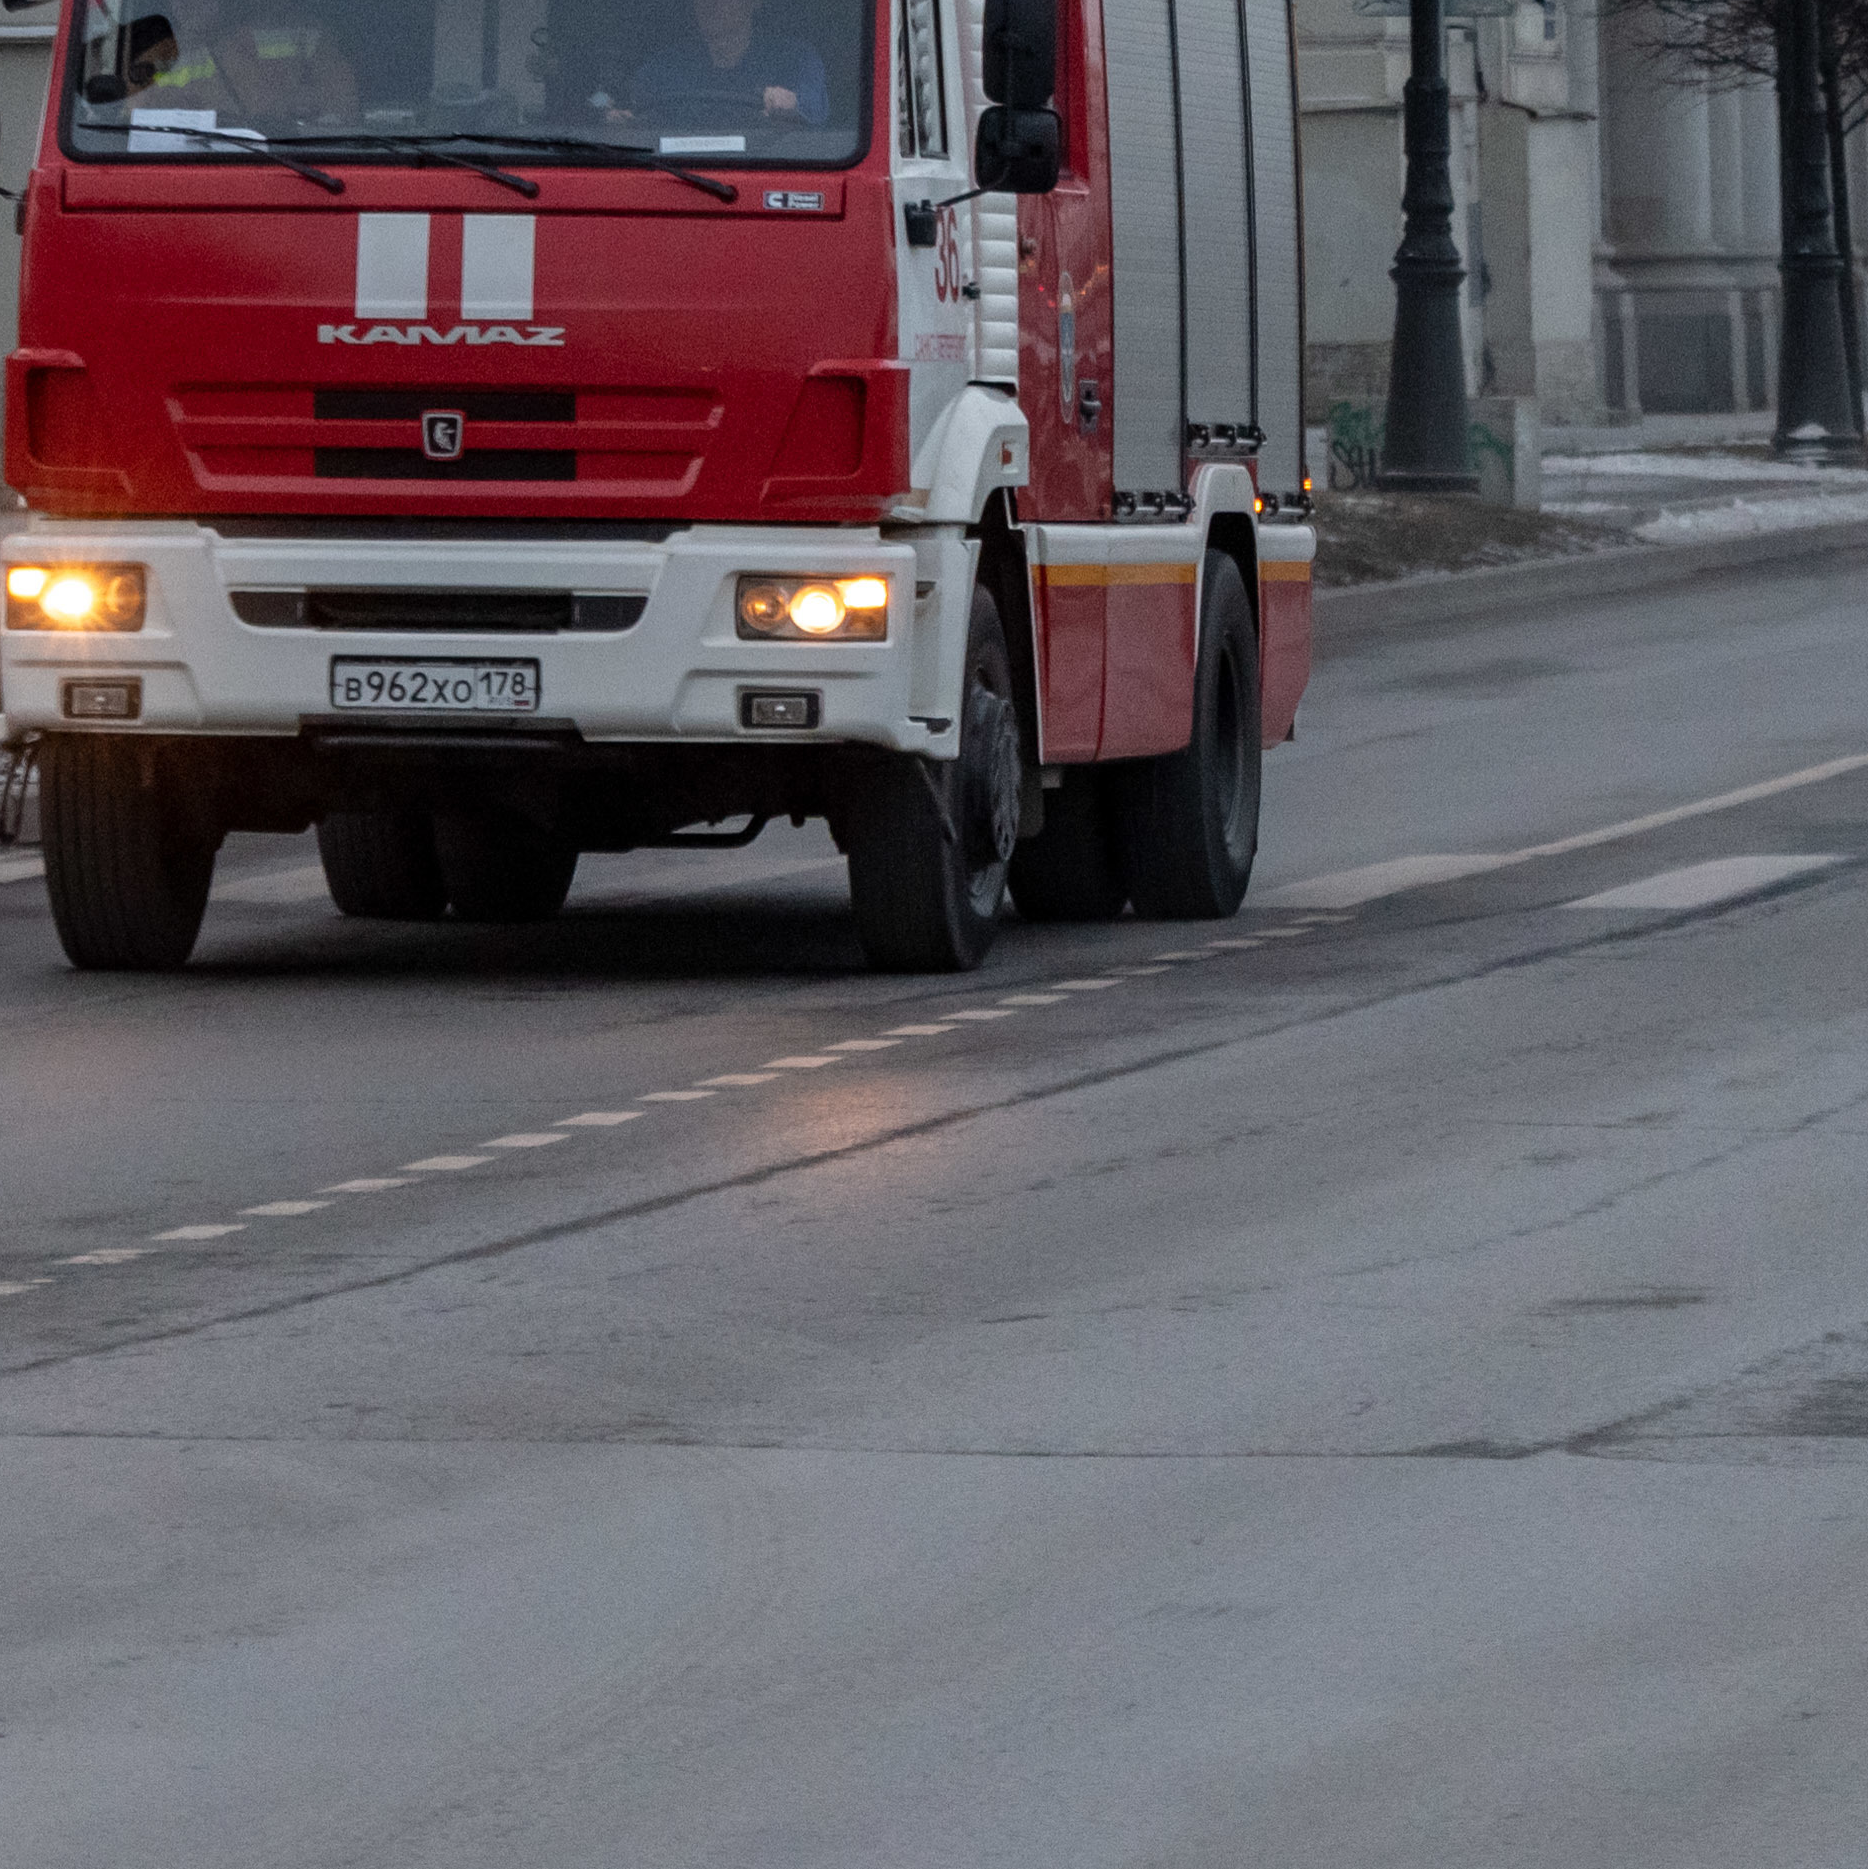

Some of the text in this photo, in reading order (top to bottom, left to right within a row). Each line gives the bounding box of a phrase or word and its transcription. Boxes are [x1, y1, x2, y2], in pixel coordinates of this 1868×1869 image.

[935, 204, 960, 304] 36
[317, 324, 566, 347] KAMAZ
[478, 671, 526, 696] 178
